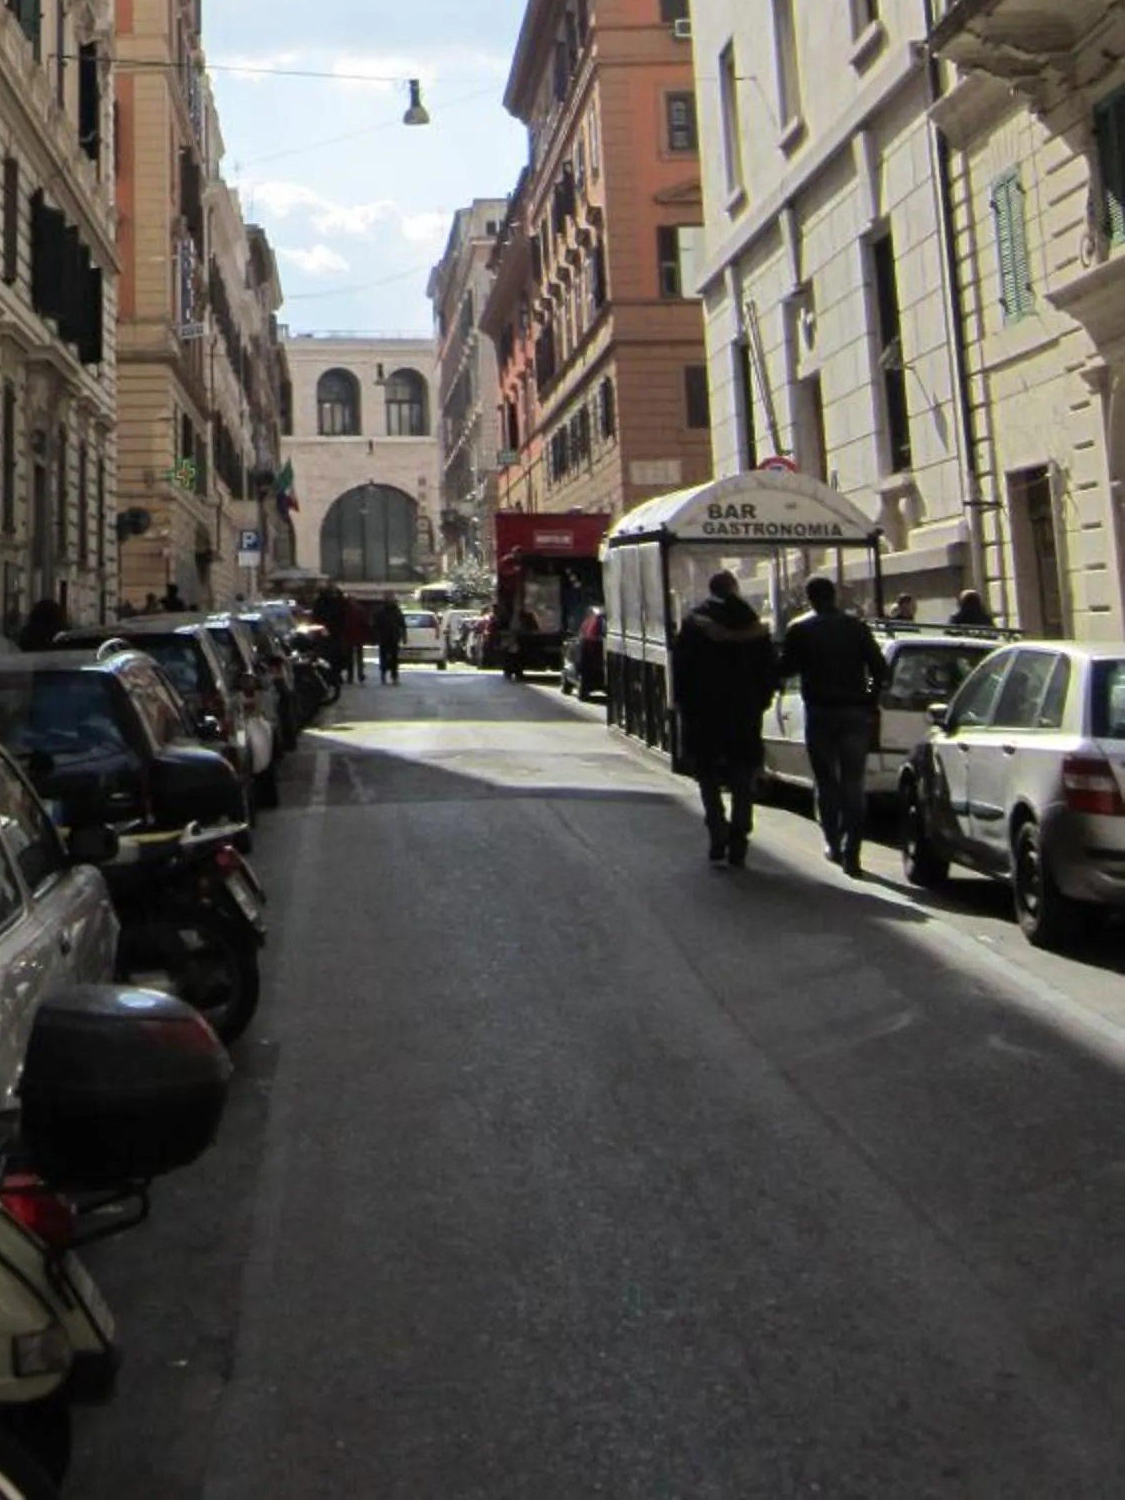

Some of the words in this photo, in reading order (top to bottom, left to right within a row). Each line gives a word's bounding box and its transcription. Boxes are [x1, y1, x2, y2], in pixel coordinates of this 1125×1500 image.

[706, 503, 756, 519] BAR
[702, 521, 843, 537] GASTRONOMIA
[242, 531, 257, 548] P
